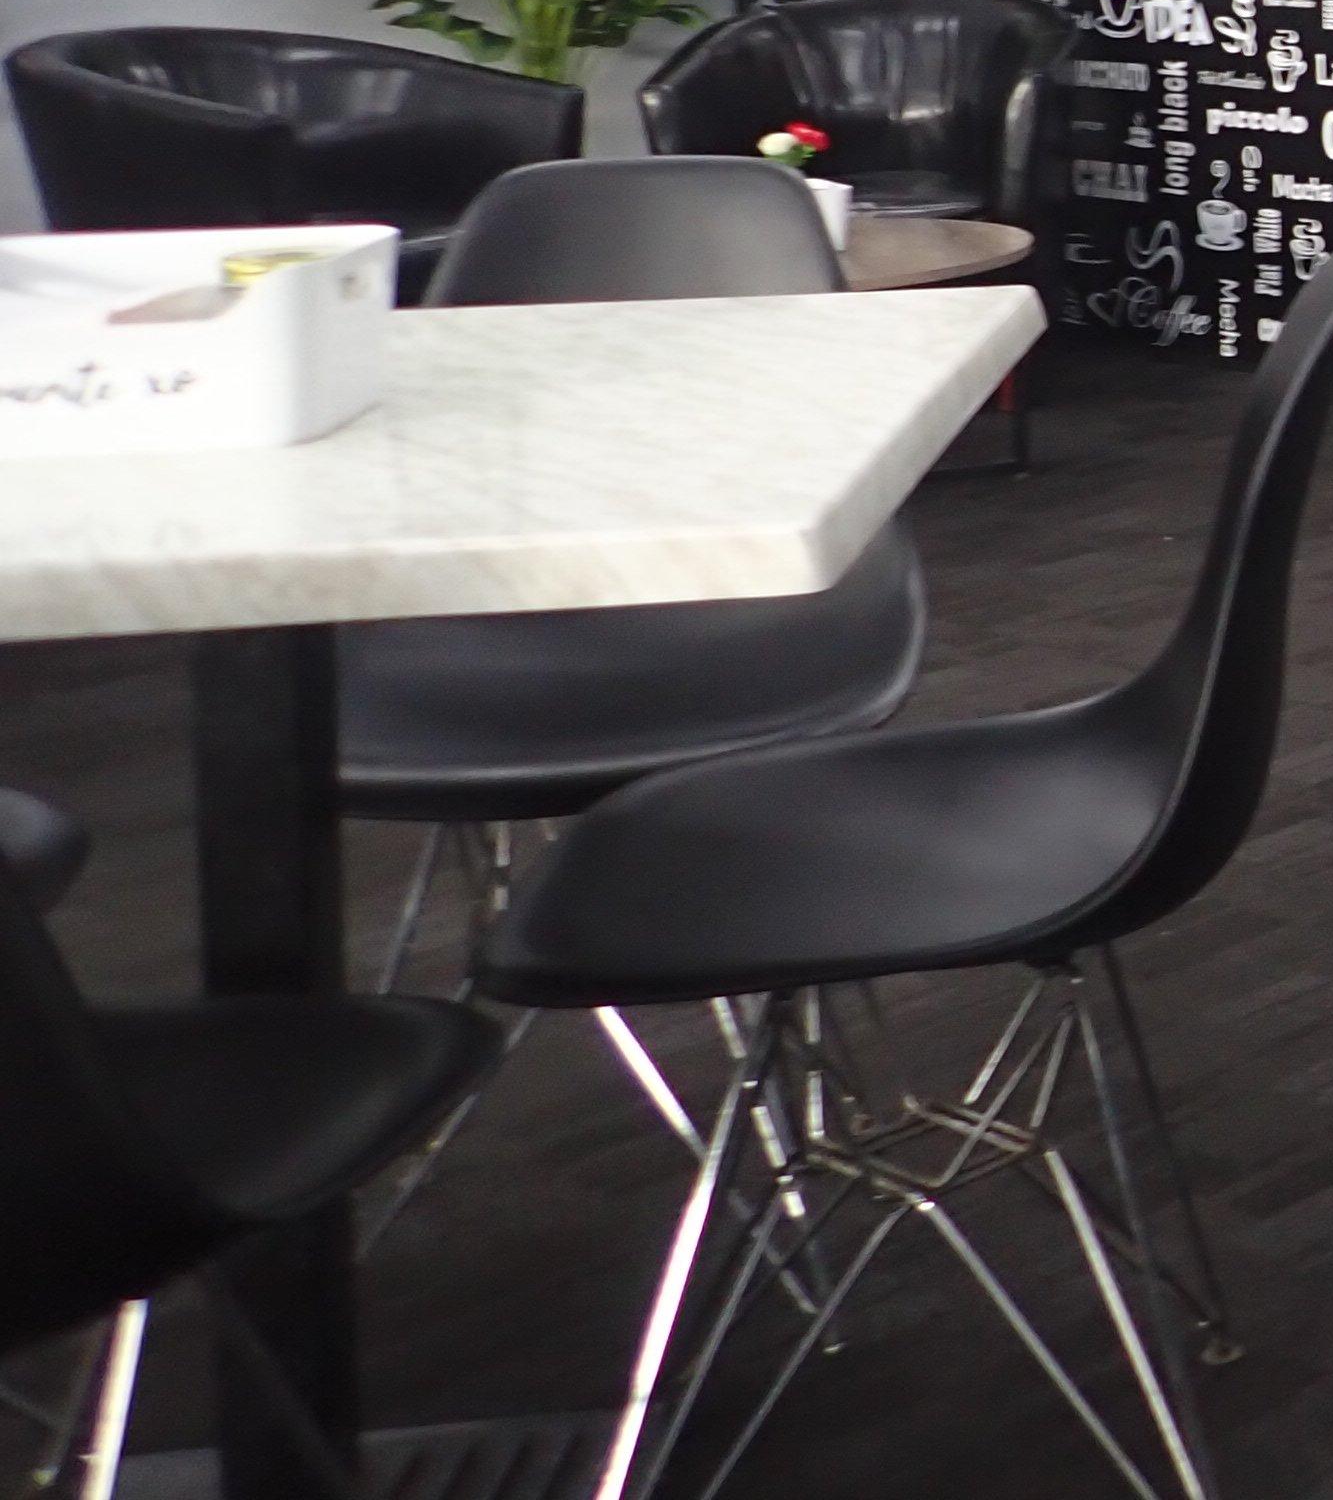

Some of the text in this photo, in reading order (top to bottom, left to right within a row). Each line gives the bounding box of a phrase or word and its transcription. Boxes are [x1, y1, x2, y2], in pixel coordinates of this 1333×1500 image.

[1156, 60, 1197, 196] long black
[1206, 101, 1310, 136] piccolo
[1253, 208, 1283, 253] White
[1254, 264, 1284, 297] Flat
